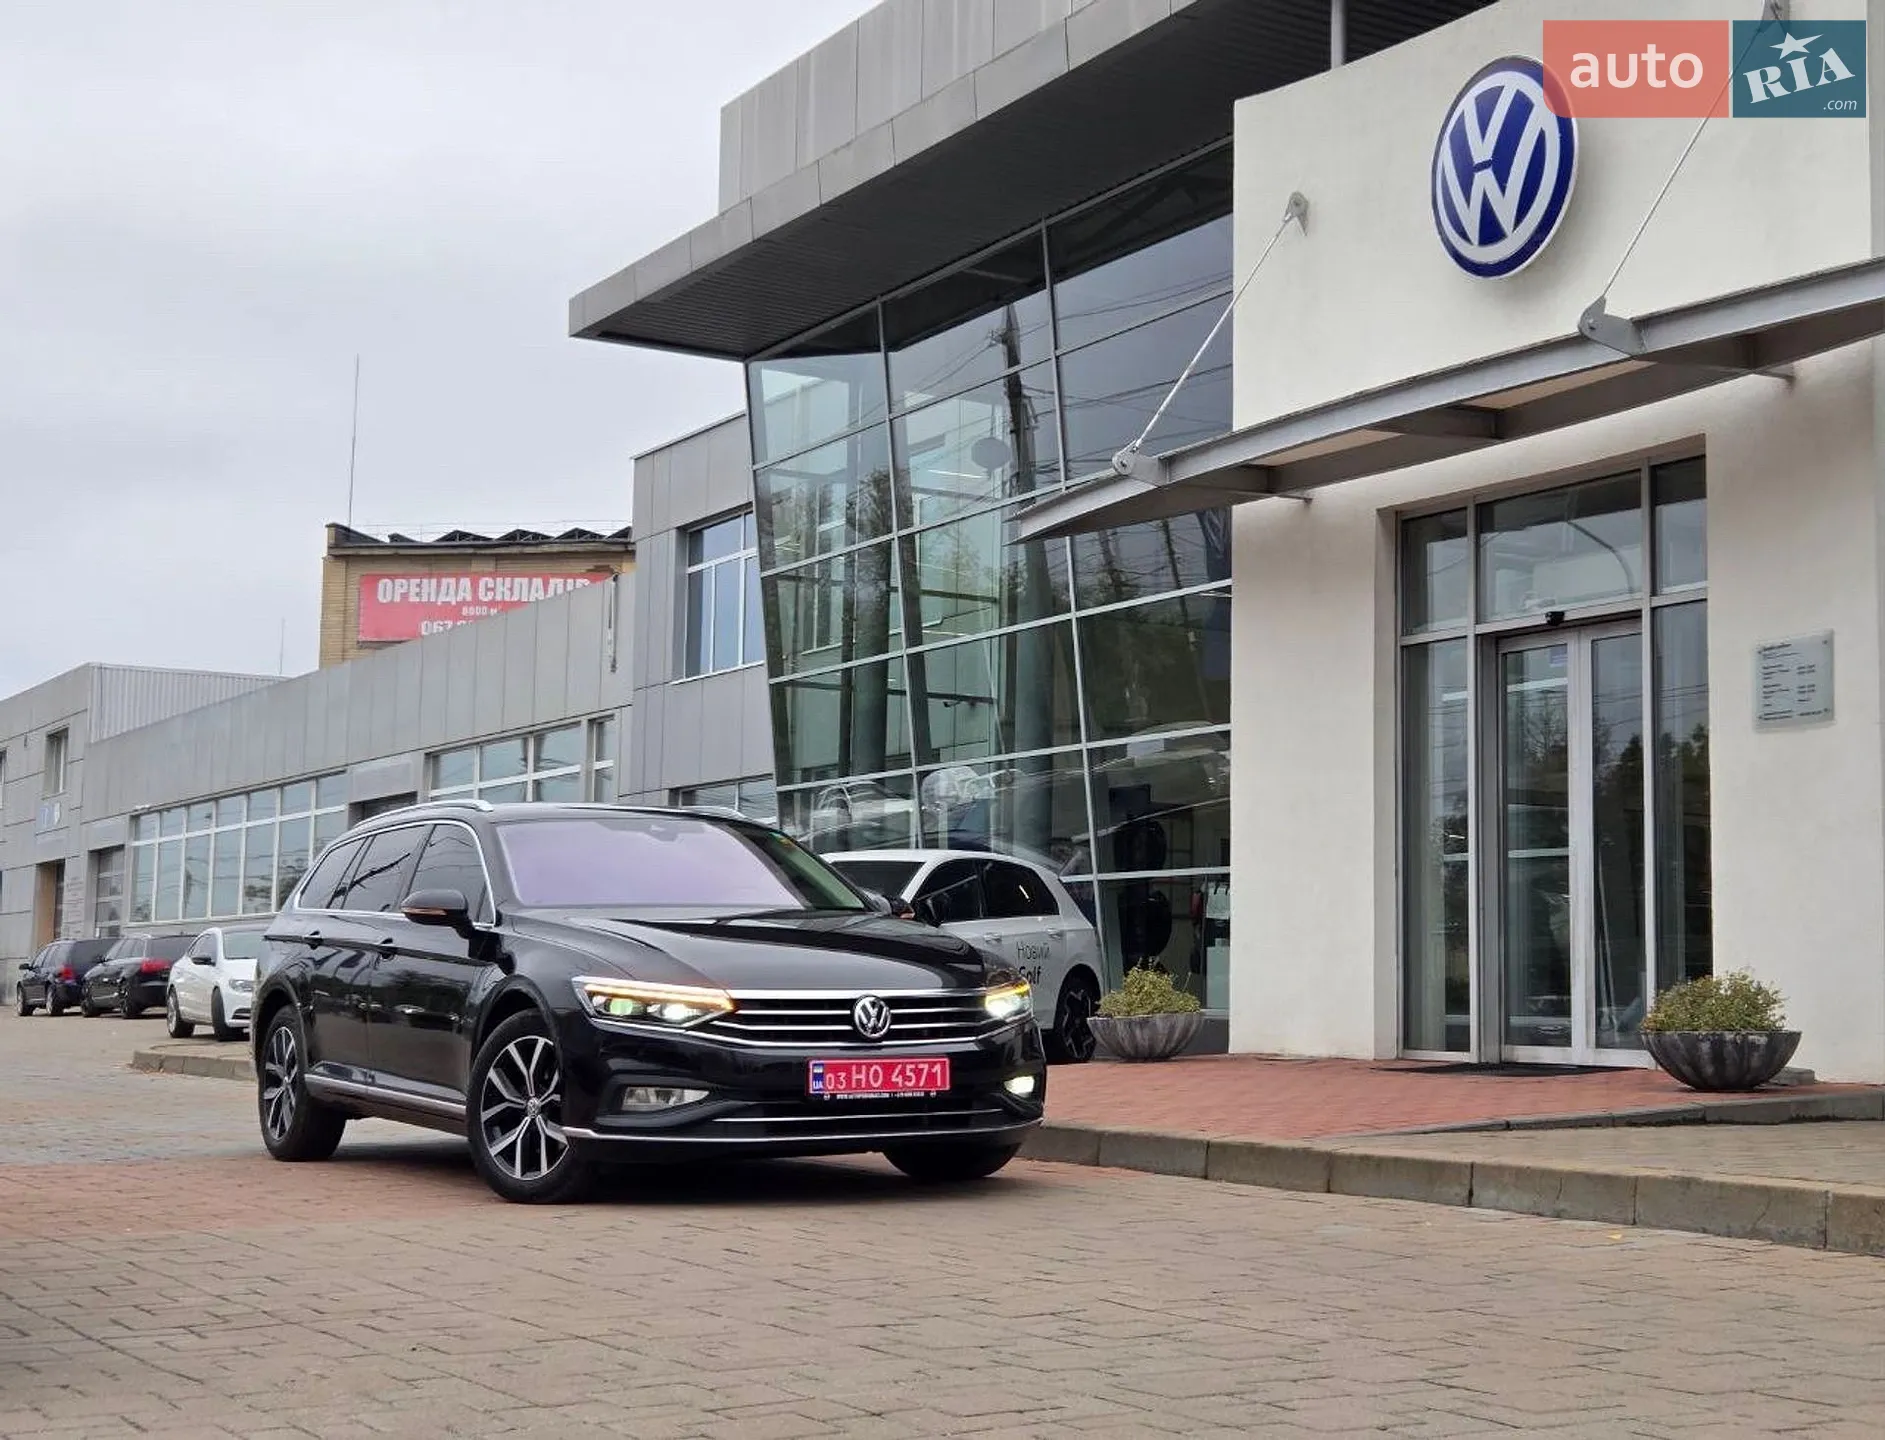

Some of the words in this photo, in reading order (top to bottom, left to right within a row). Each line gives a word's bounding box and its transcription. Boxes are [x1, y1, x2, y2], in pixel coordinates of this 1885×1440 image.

[377, 577, 473, 605] ОРЕНДА
[1016, 941, 1050, 960] Новий
[813, 1080, 824, 1090] UA
[826, 1072, 847, 1090] 03
[891, 1063, 942, 1087] 4571
